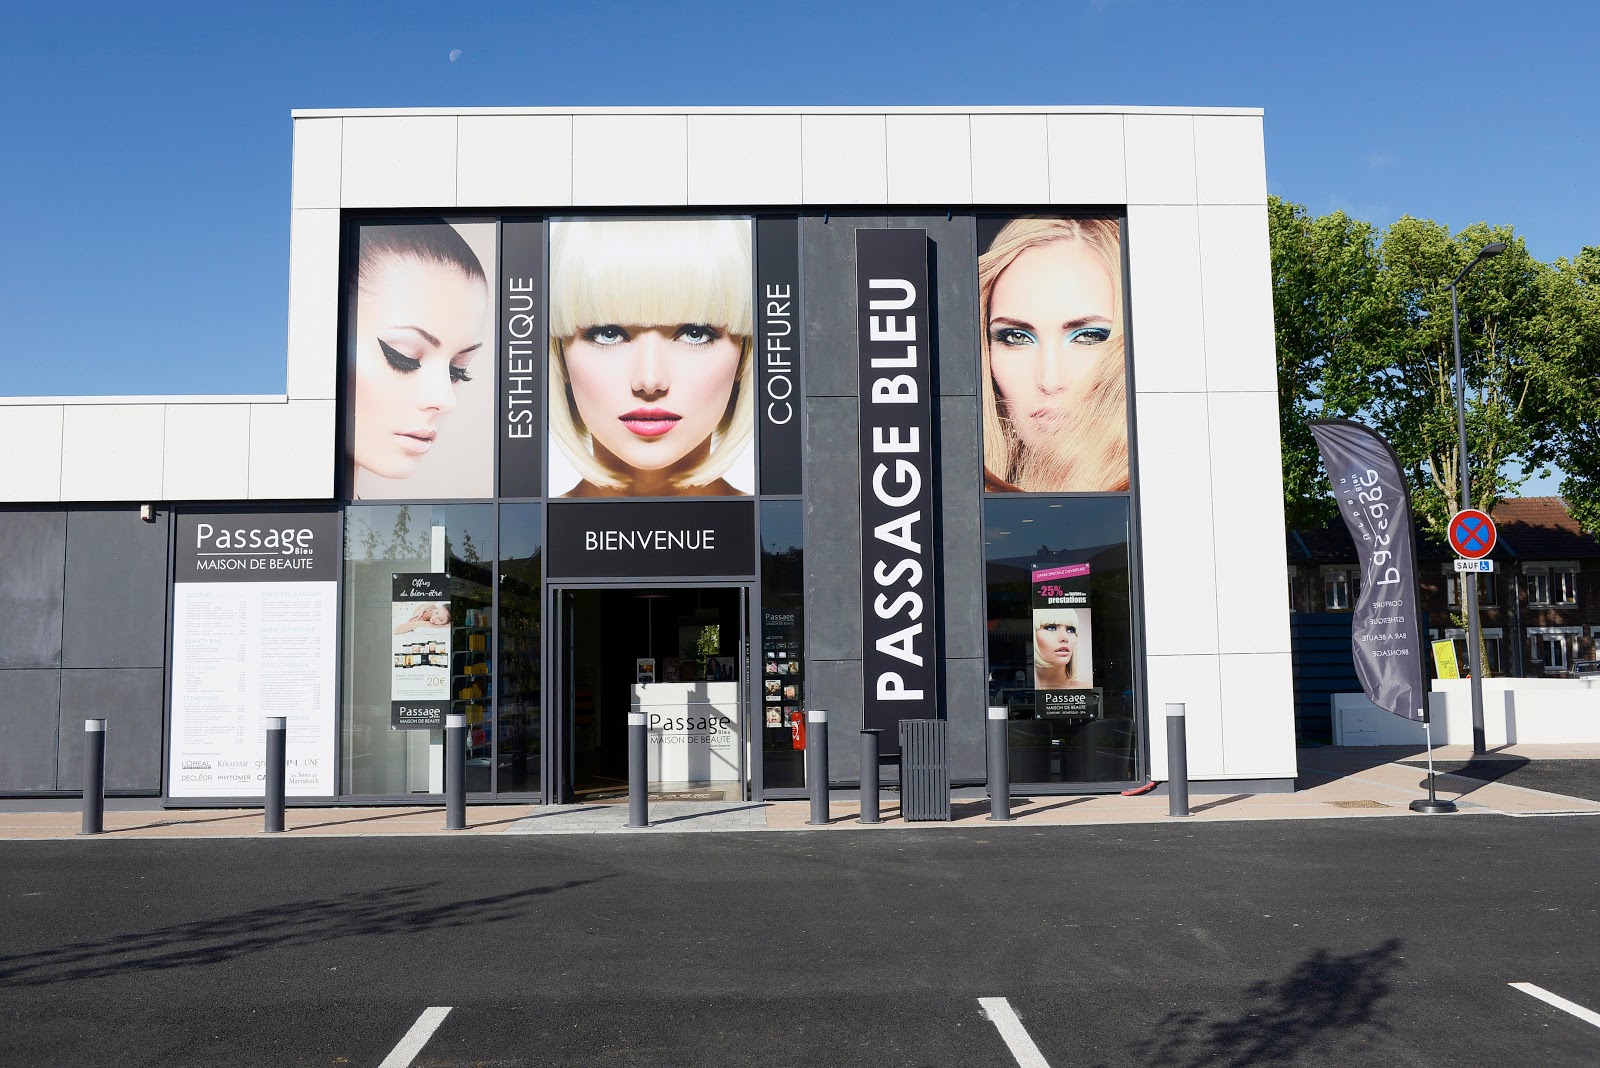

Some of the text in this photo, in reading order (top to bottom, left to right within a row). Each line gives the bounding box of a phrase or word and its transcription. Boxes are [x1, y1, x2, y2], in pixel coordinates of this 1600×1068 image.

[508, 278, 534, 438] ESTHETIQUE
[766, 284, 792, 424] COIFFURE
[869, 278, 924, 700] PASSAGE BLEU
[196, 523, 314, 555] Passage
[586, 530, 714, 550] BIENVENUE
[196, 558, 313, 570] MAISON DE BEAUTE
[411, 579, 430, 587] Offrez
[410, 588, 442, 597] bien-être
[1037, 585, 1063, 596] -25%
[1048, 596, 1086, 604] prestations
[427, 676, 446, 686] 20€
[1046, 693, 1086, 704] Passage
[400, 706, 440, 718] Passage
[650, 714, 731, 735] Passage
[255, 759, 266, 769] gh
